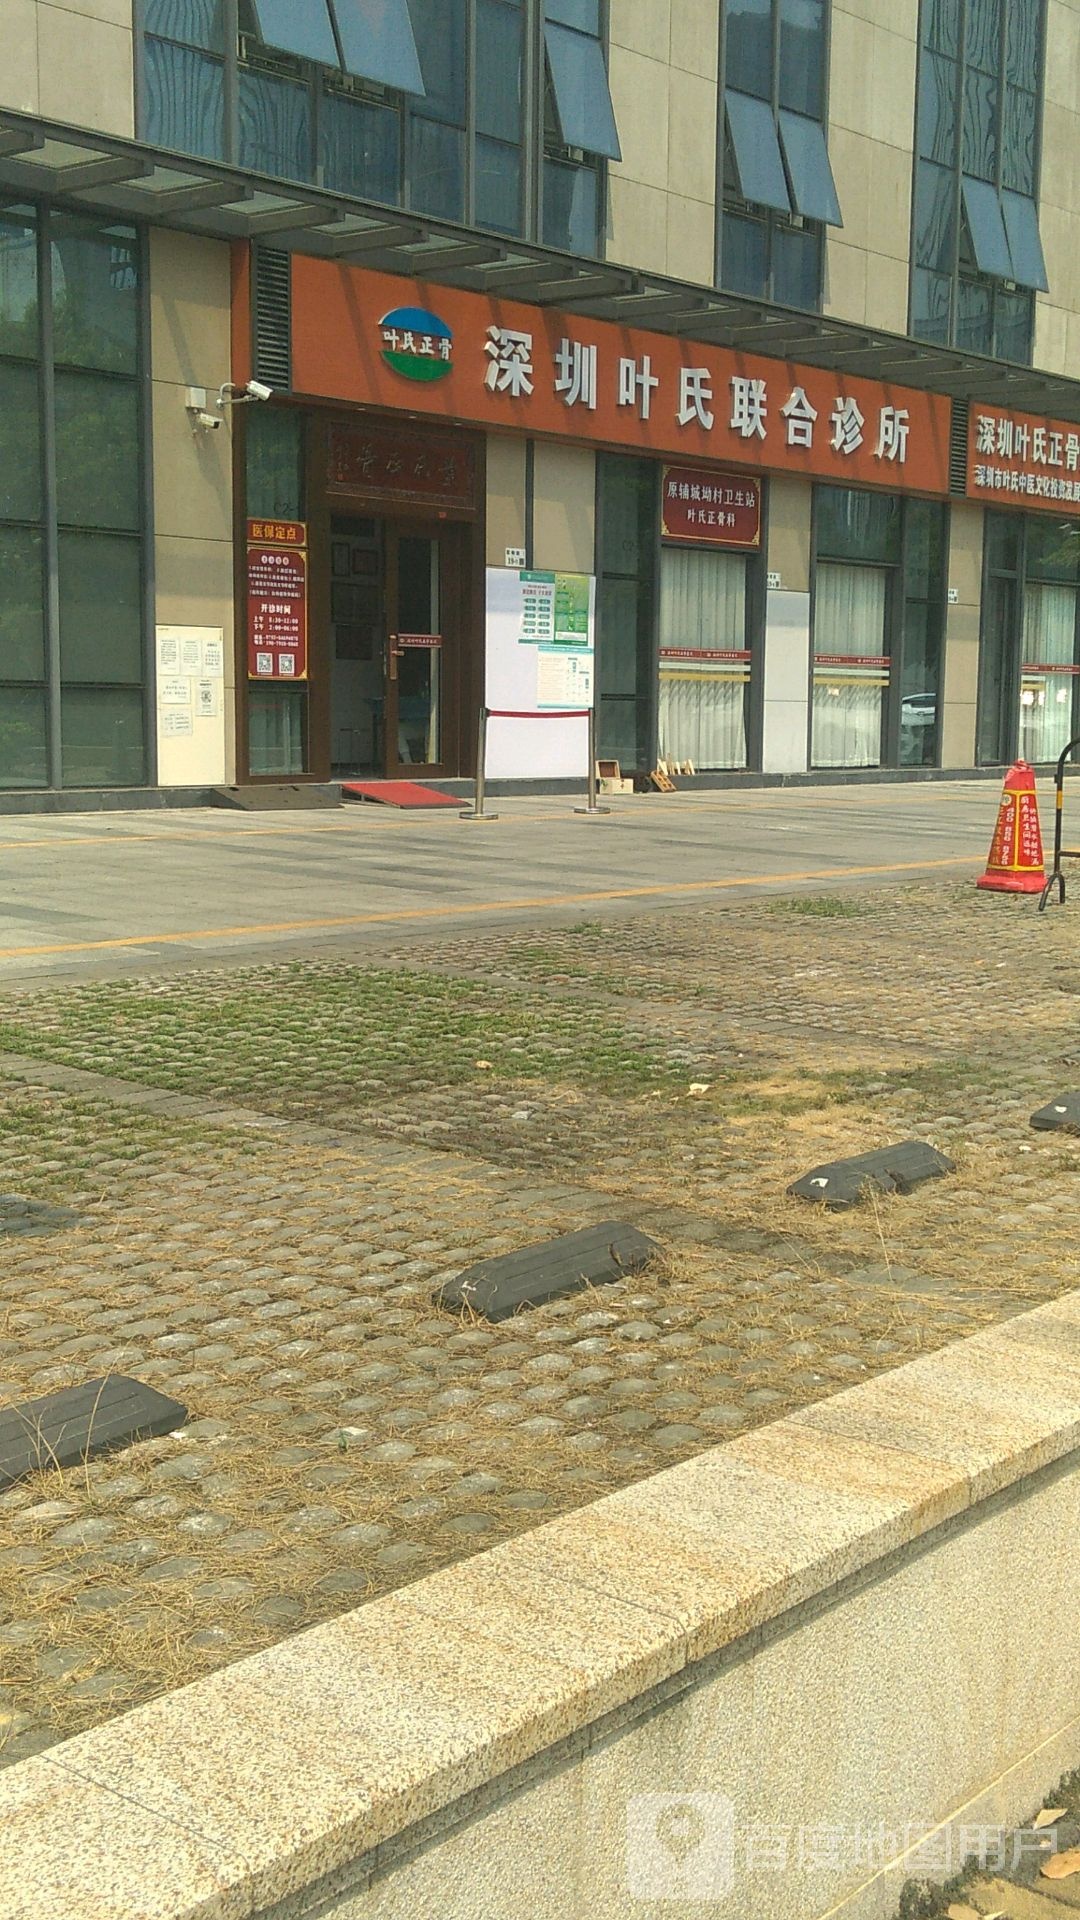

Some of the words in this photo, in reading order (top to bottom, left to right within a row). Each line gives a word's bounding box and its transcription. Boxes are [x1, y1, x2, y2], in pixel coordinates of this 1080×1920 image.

[383, 328, 452, 361] 叶氏正骨
[483, 325, 909, 463] 深圳叶氏联合诊所
[976, 415, 1080, 472] 深圳叶氏正骨
[667, 481, 755, 508] 原辅城坳村卫生站
[252, 523, 296, 540] 医保定点
[687, 509, 736, 528] 叶氏正骨科
